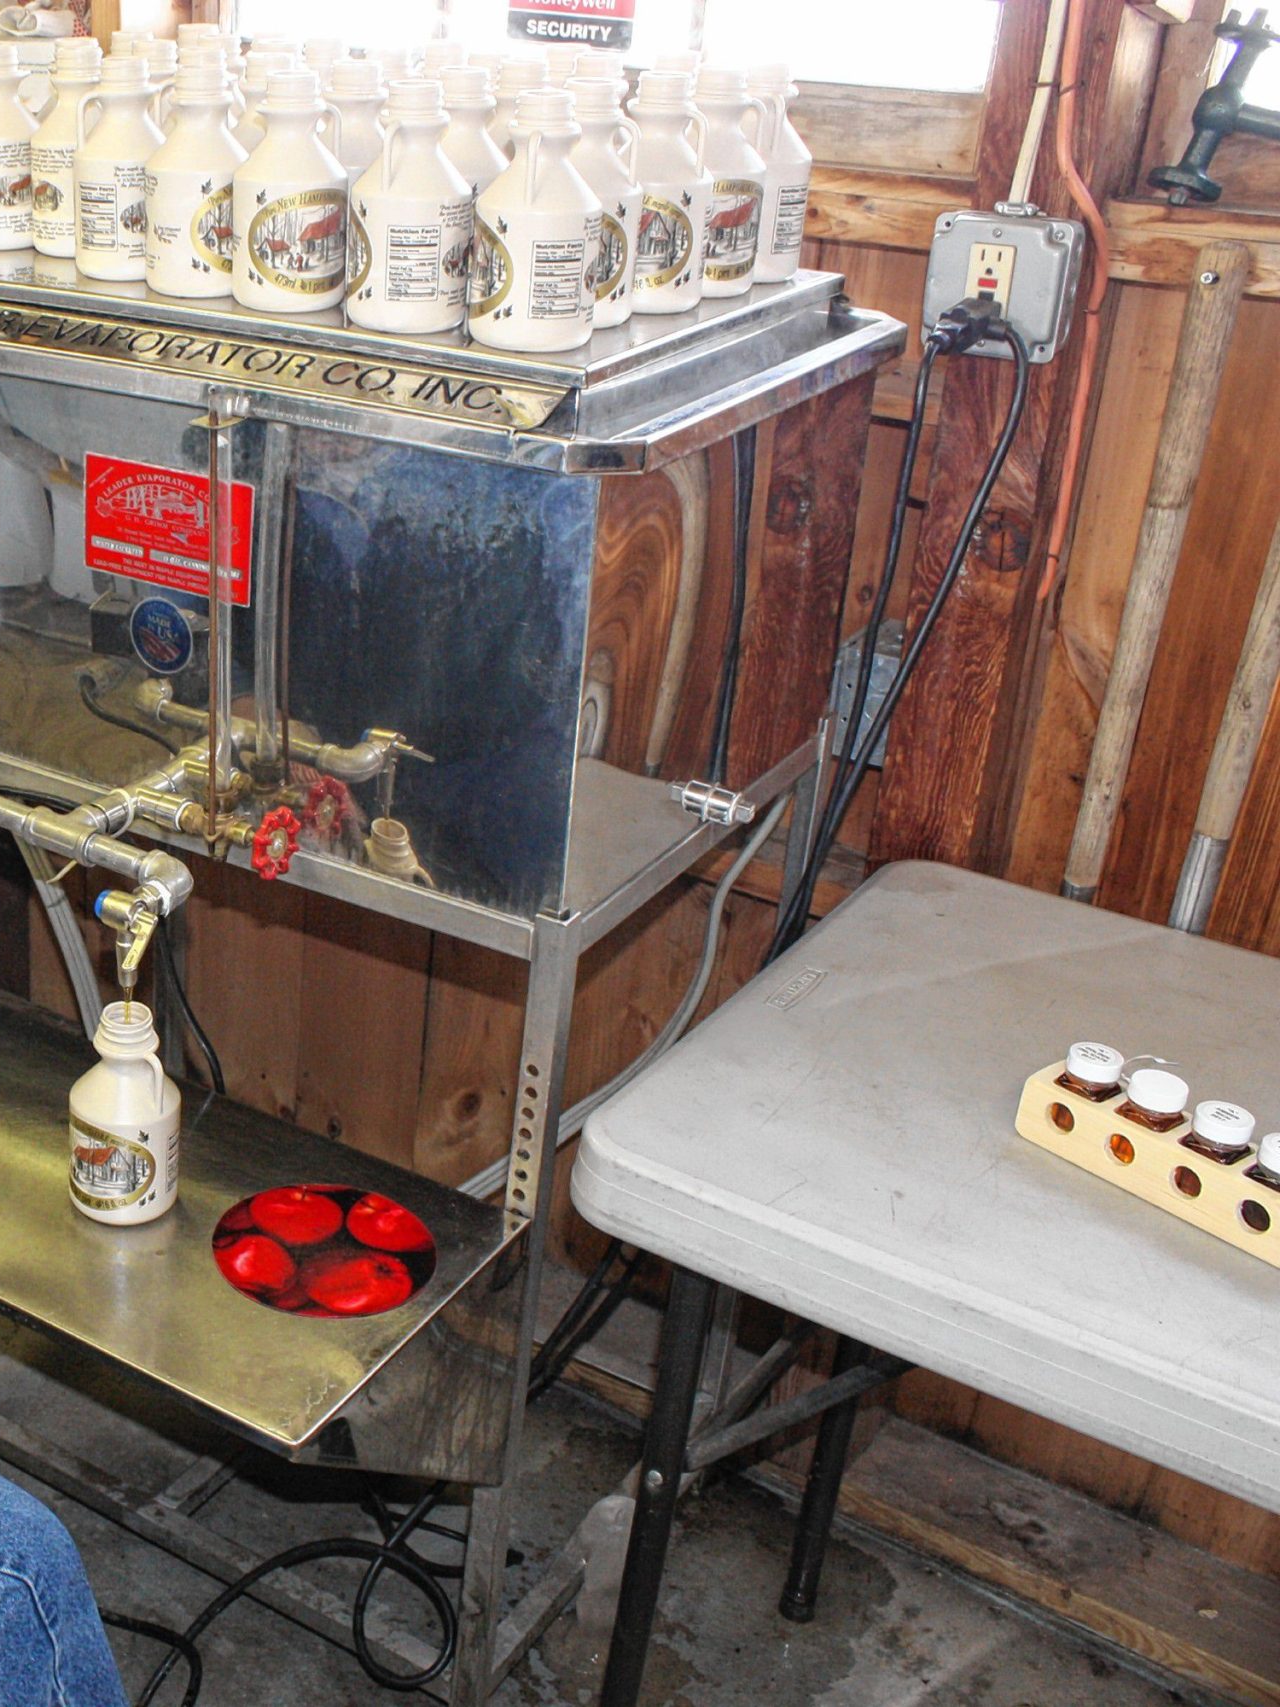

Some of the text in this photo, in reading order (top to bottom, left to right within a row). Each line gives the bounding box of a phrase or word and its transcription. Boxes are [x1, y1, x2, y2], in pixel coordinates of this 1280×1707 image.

[526, 19, 612, 42] SECURITY
[21, 315, 317, 379] EVAPORATOR
[321, 361, 396, 395] CO.
[410, 374, 503, 414] INC.
[102, 476, 134, 498] LEADER
[136, 473, 196, 493] EVAPORATOR
